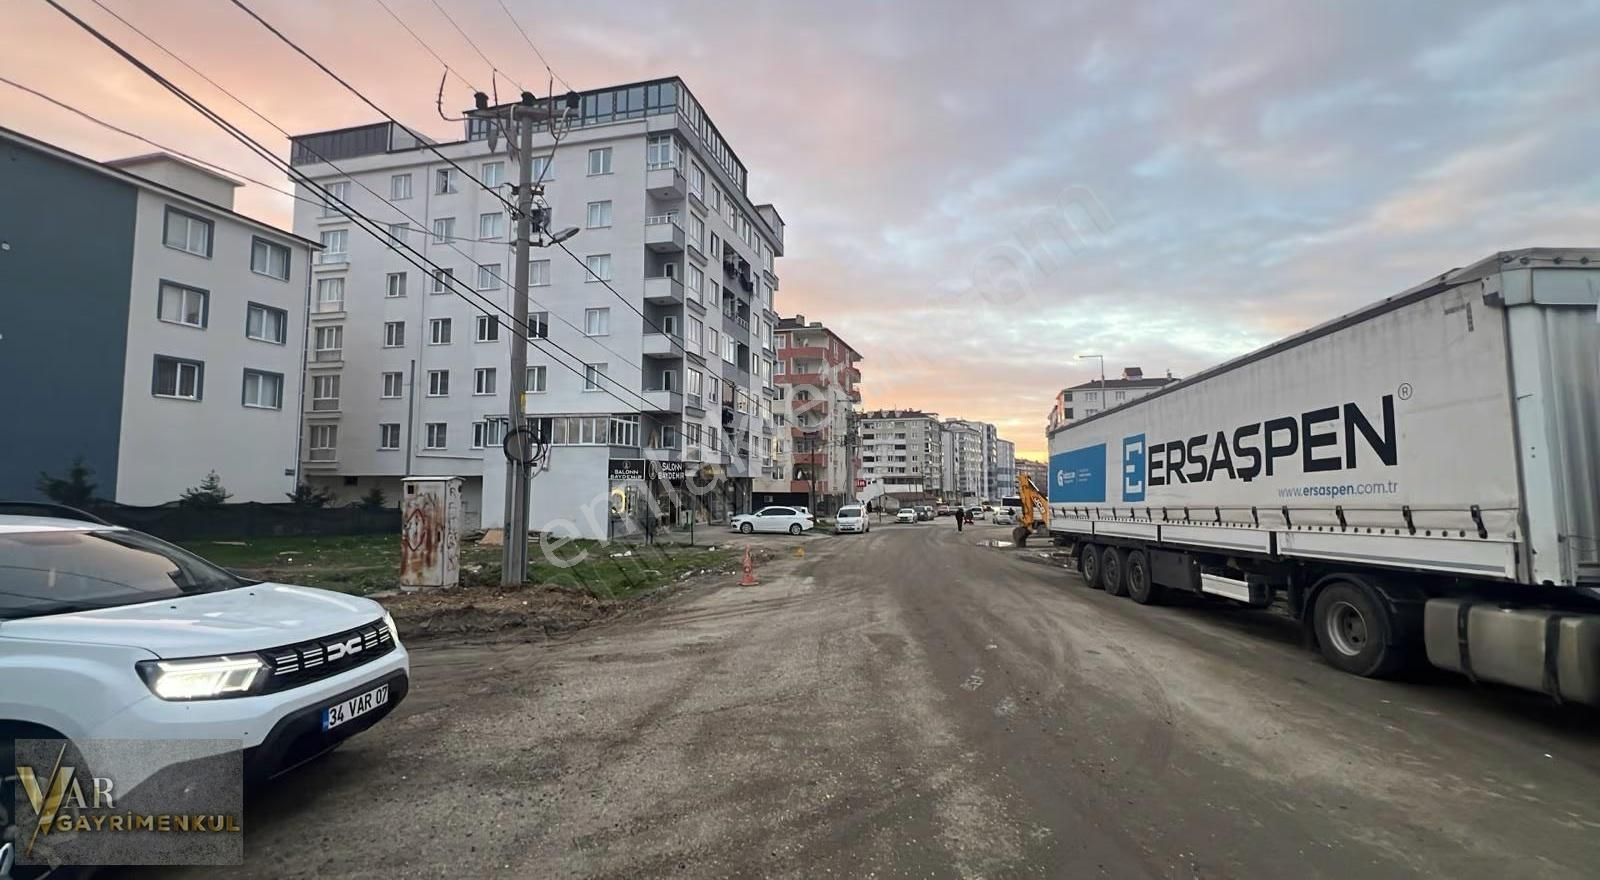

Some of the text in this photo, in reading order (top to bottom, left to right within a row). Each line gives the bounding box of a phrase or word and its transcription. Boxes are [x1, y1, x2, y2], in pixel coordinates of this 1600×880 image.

[1148, 394, 1398, 487] ERSAŞPEN
[1278, 480, 1398, 499] www.ersaspen.com.tr
[329, 686, 388, 726] 34 VAR 07
